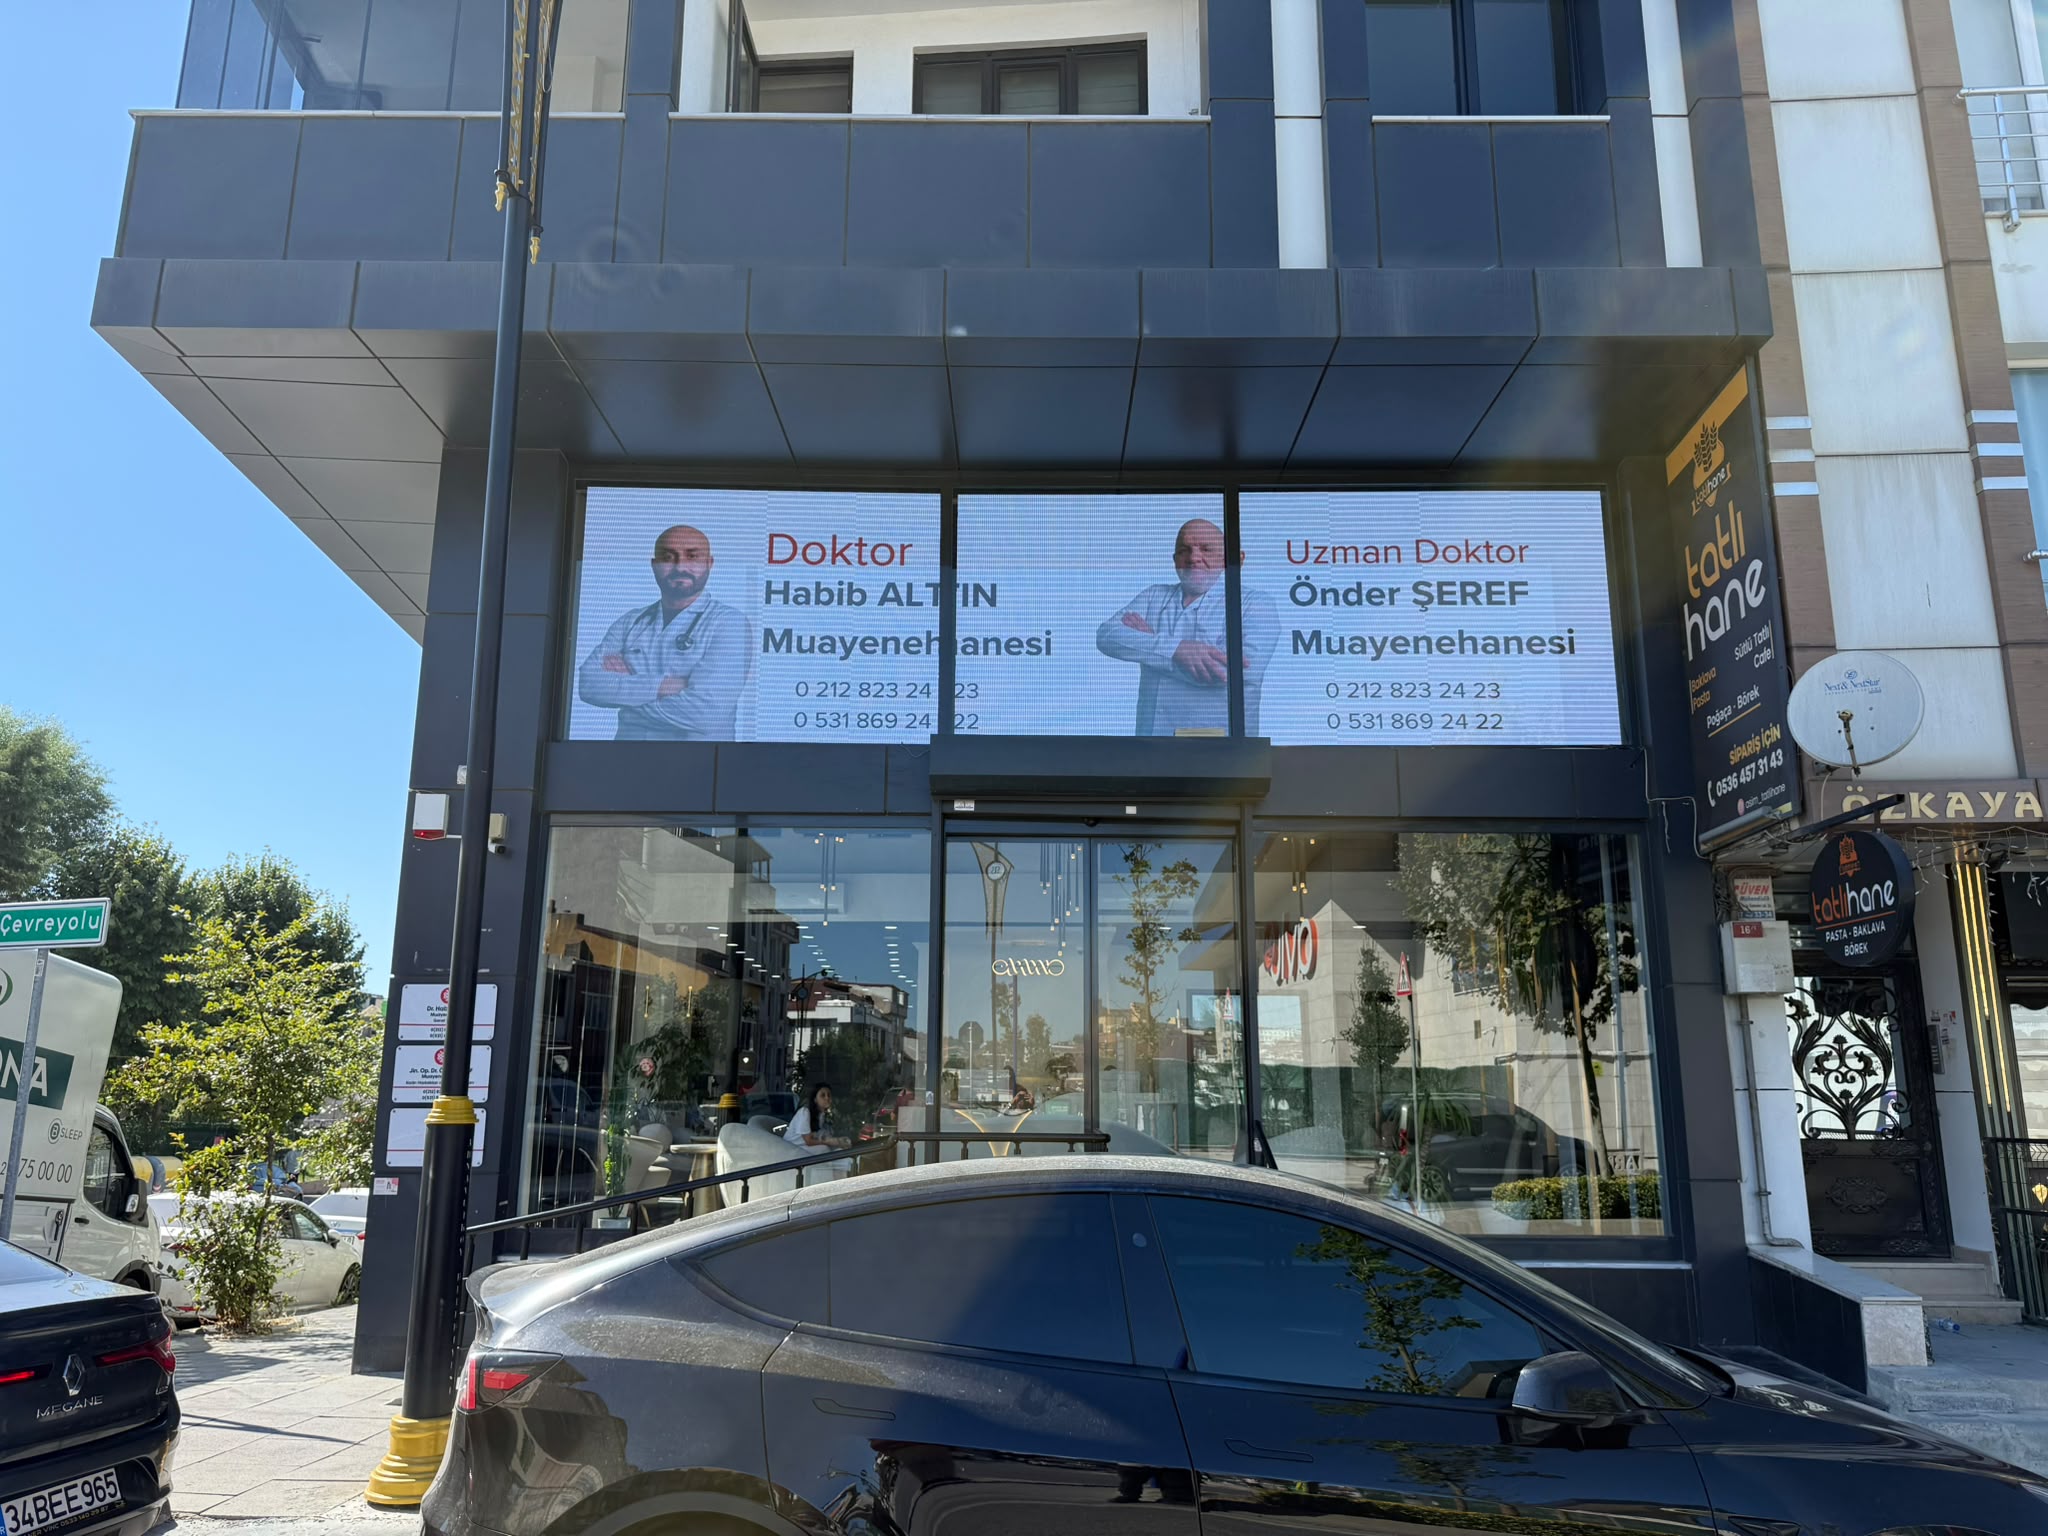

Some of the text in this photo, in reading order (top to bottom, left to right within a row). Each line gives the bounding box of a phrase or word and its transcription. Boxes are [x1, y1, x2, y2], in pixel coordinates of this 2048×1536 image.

[768, 533, 912, 566] Doktor
[1286, 538, 1529, 564] Uzman Doktor
[765, 580, 867, 607] Habib
[1289, 575, 1529, 612] Önder ŞEREF
[1683, 559, 1766, 662] hane
[1291, 629, 1575, 661] Muayenehanesi
[1734, 624, 1770, 660] Sütlü Tatlı
[1754, 647, 1772, 668] Cafe
[796, 681, 979, 699] 0 212 823 24 23
[1326, 682, 1501, 699] 0 212 823 24 23
[1692, 667, 1716, 692] Baklava
[1694, 690, 1710, 710] Pasta
[1706, 705, 1732, 729] Poğaça
[1736, 684, 1760, 710] Börek
[794, 712, 979, 730] 0 531 869 24 22
[1327, 713, 1504, 730] 0 531 869 24 22
[1729, 722, 1781, 765] SİPARİŞ İÇİN
[1716, 748, 1784, 798] 0536 457 31 43
[1842, 786, 2044, 821] ÖZKAYA
[0, 910, 100, 936] Çevreyolu
[1826, 928, 1848, 942] PASTA
[1853, 920, 1886, 938] BAKLAVA
[1844, 942, 1868, 956] BÖREK
[60, 1127, 82, 1141] SLEEP
[18, 1158, 36, 1179] 75
[38, 1160, 54, 1181] 00
[56, 1163, 72, 1183] 00
[36, 1394, 104, 1419] MEGANE
